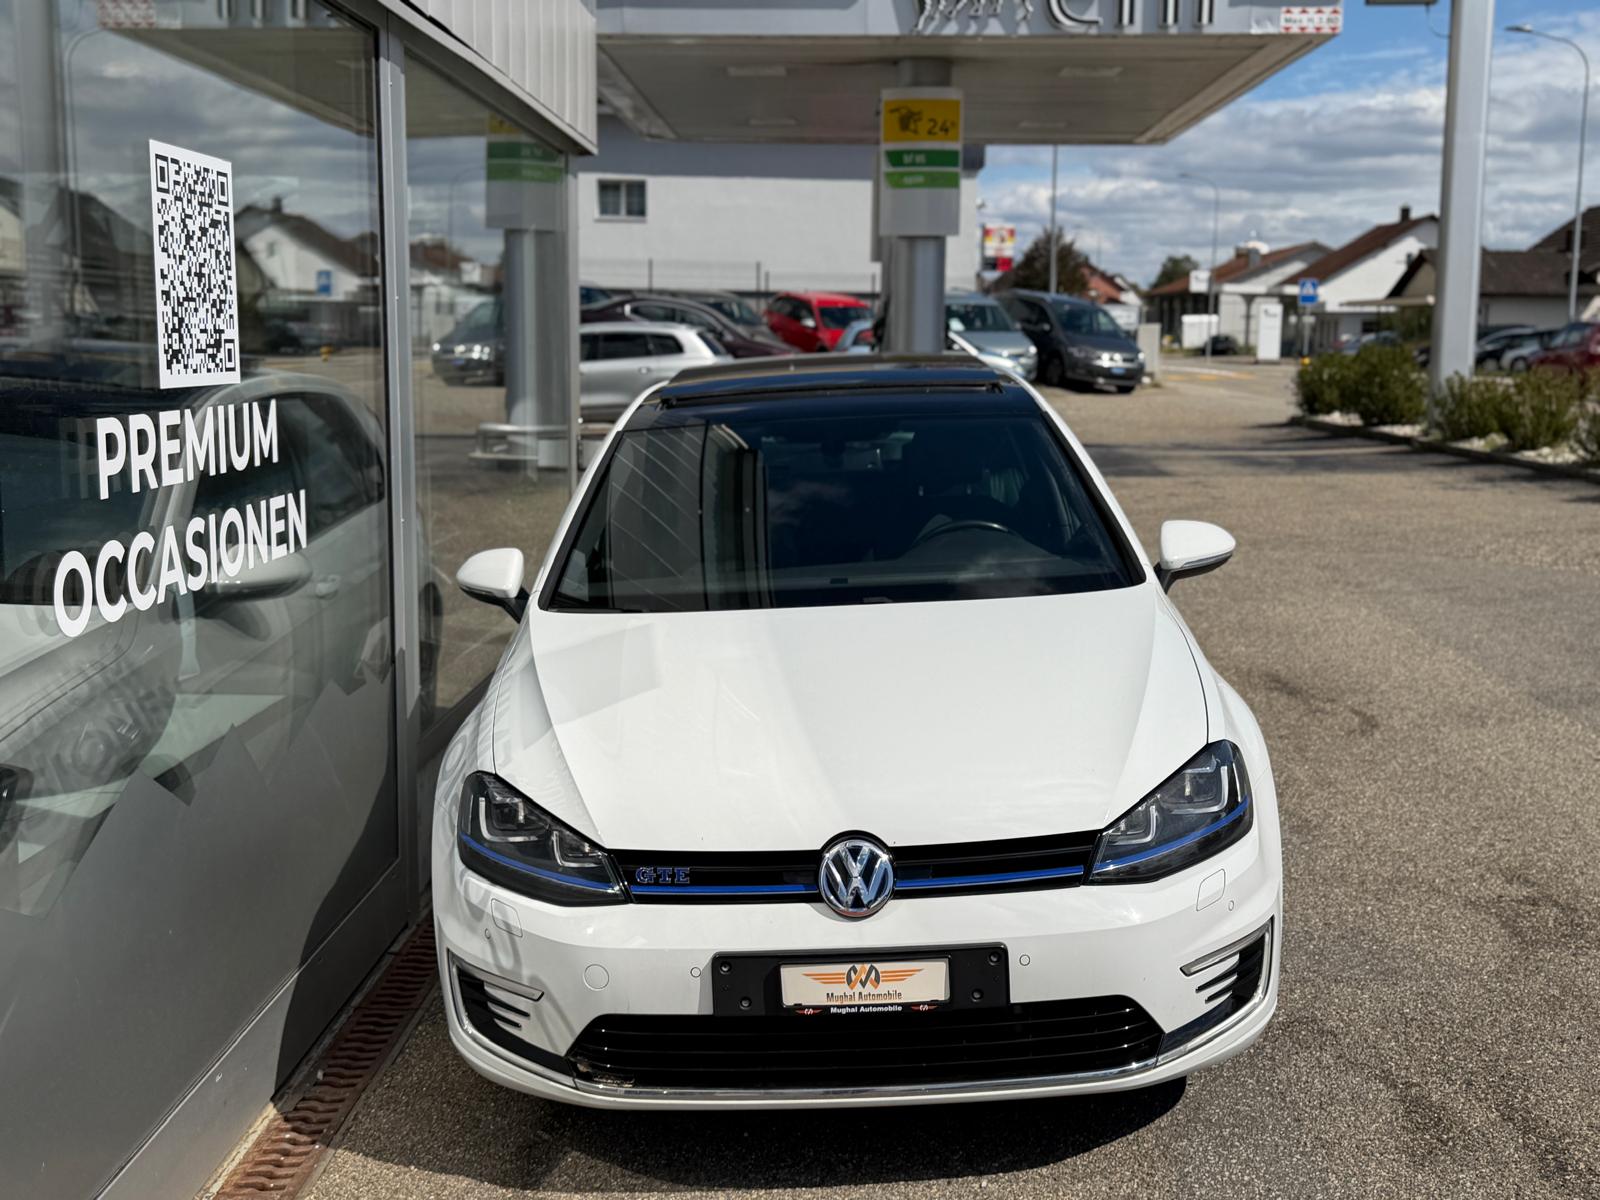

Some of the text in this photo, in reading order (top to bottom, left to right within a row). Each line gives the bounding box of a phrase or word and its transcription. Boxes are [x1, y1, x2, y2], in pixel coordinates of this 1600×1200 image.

[96, 398, 279, 501] PREMIUM
[53, 488, 308, 638] OCCASIONEN
[635, 866, 691, 884] GTE
[826, 989, 903, 1004] Mughal Automobile
[830, 1004, 903, 1015] Mughal Automobile
